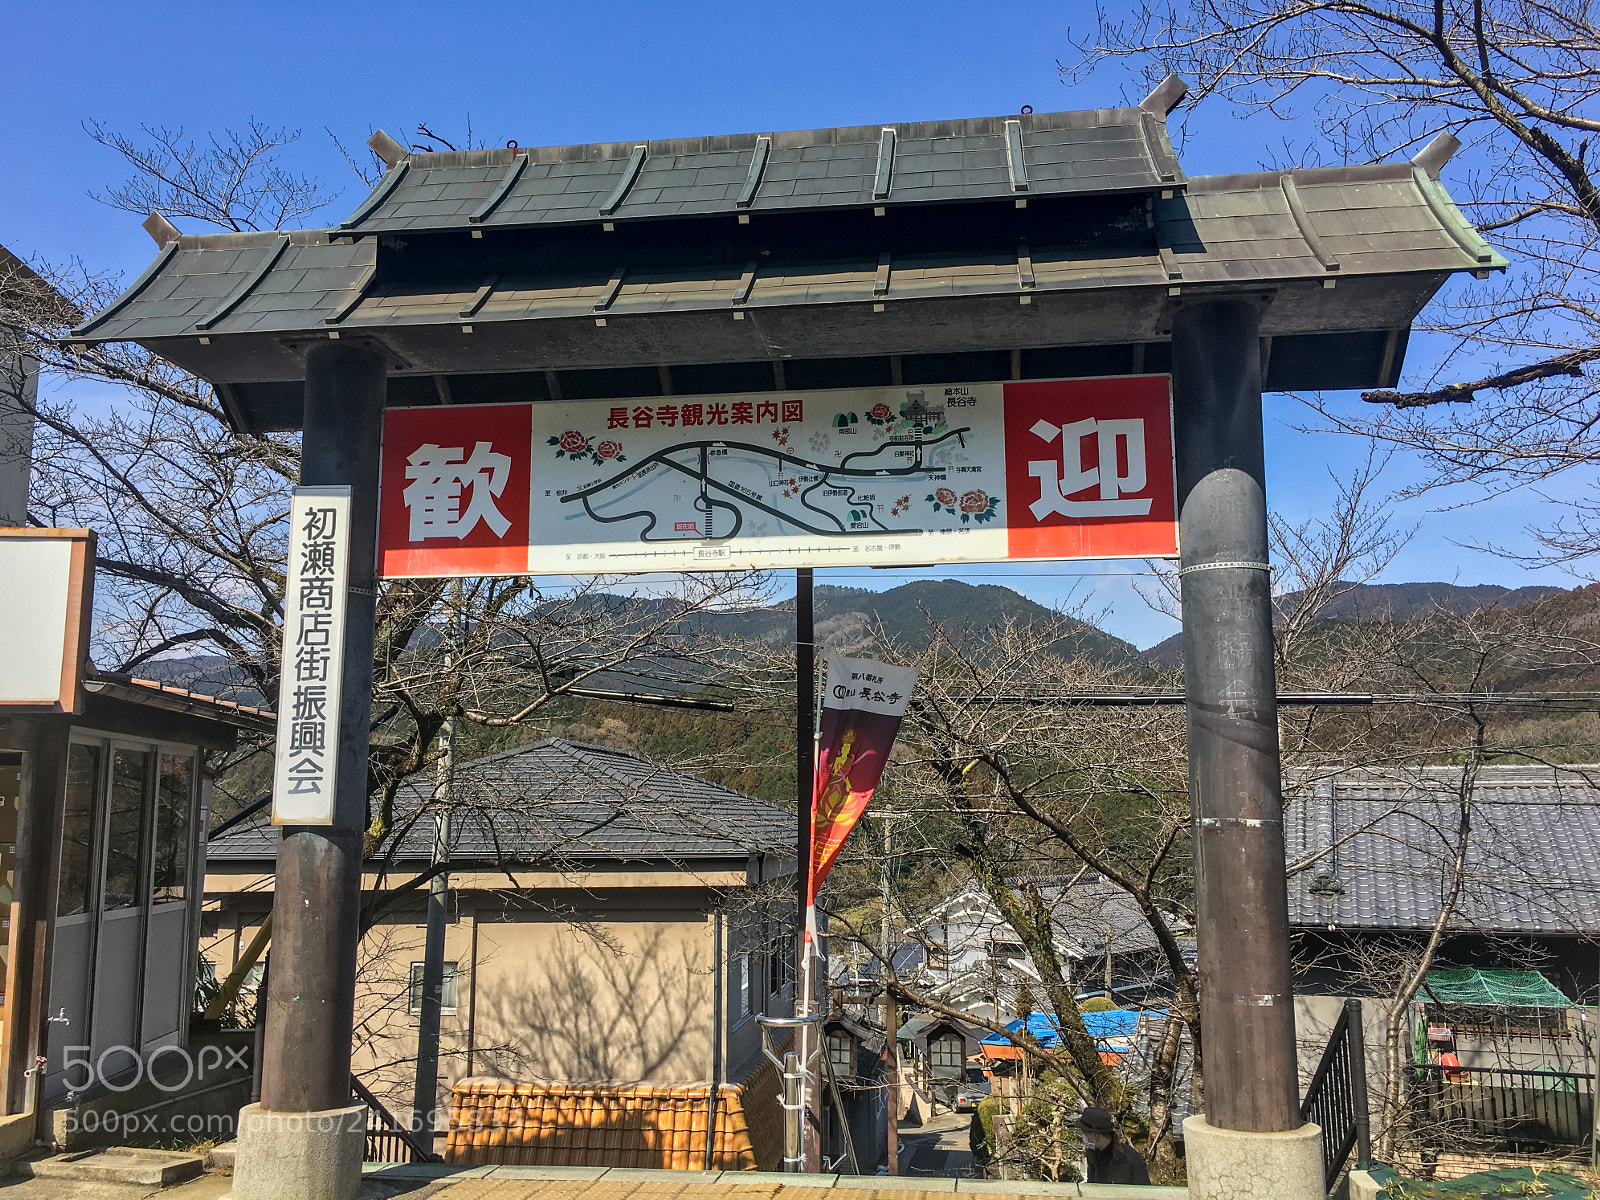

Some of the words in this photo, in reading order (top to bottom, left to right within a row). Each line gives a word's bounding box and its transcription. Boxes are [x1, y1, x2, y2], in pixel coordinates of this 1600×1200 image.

[947, 396, 977, 407] 長谷寺
[606, 400, 804, 430] 長谷寺観光案内図
[1028, 416, 1152, 523] 迎
[403, 441, 512, 542] 歓
[698, 549, 726, 557] 長谷寺駅
[287, 507, 337, 794] 初瀬商店街振興会
[851, 672, 884, 684] 第八番札所
[859, 687, 903, 704] 長谷寺
